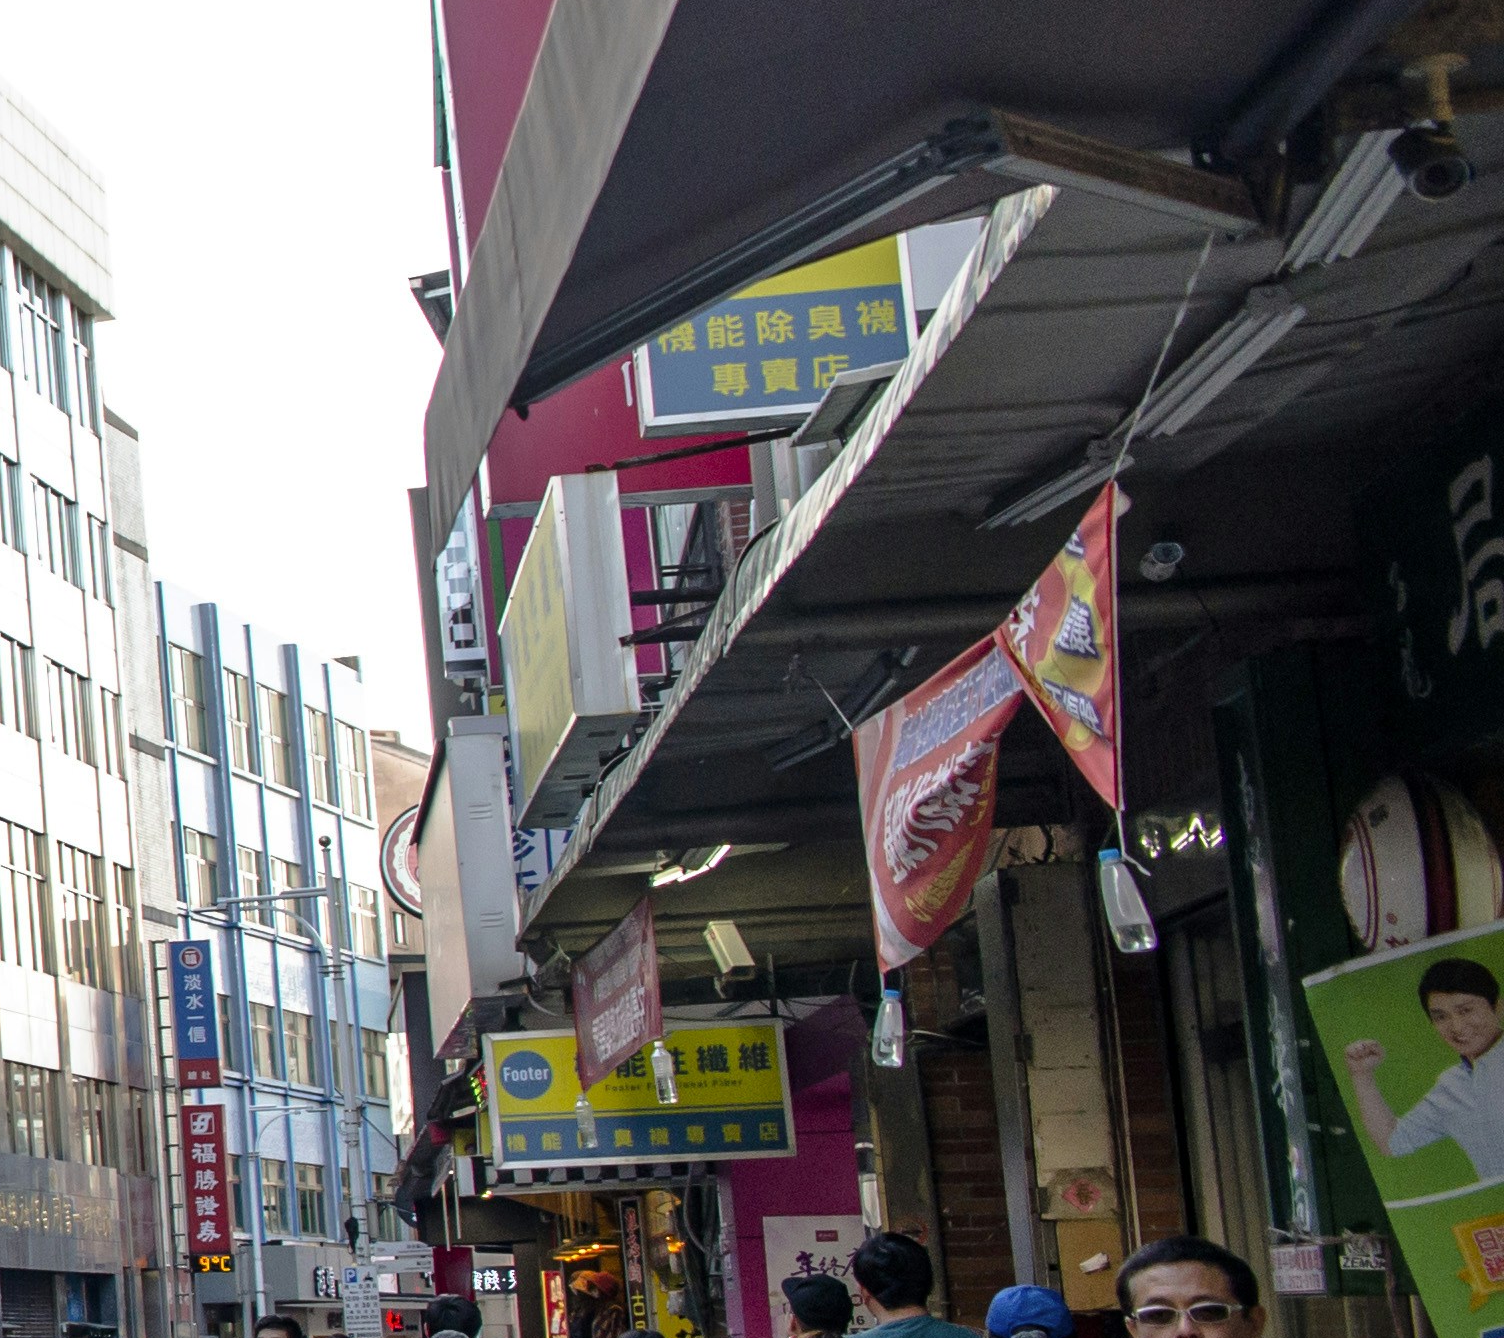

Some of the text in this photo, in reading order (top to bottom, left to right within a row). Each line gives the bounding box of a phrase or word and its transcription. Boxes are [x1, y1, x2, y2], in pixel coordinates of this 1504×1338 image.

[712, 353, 849, 396] 專賣店
[184, 974, 206, 1043] 淡水一信
[503, 1067, 550, 1082] Footer
[577, 1041, 772, 1078] 能性纖維
[507, 1123, 778, 1152] 機能臭襪專賣店
[192, 1143, 220, 1242] 福勝證券
